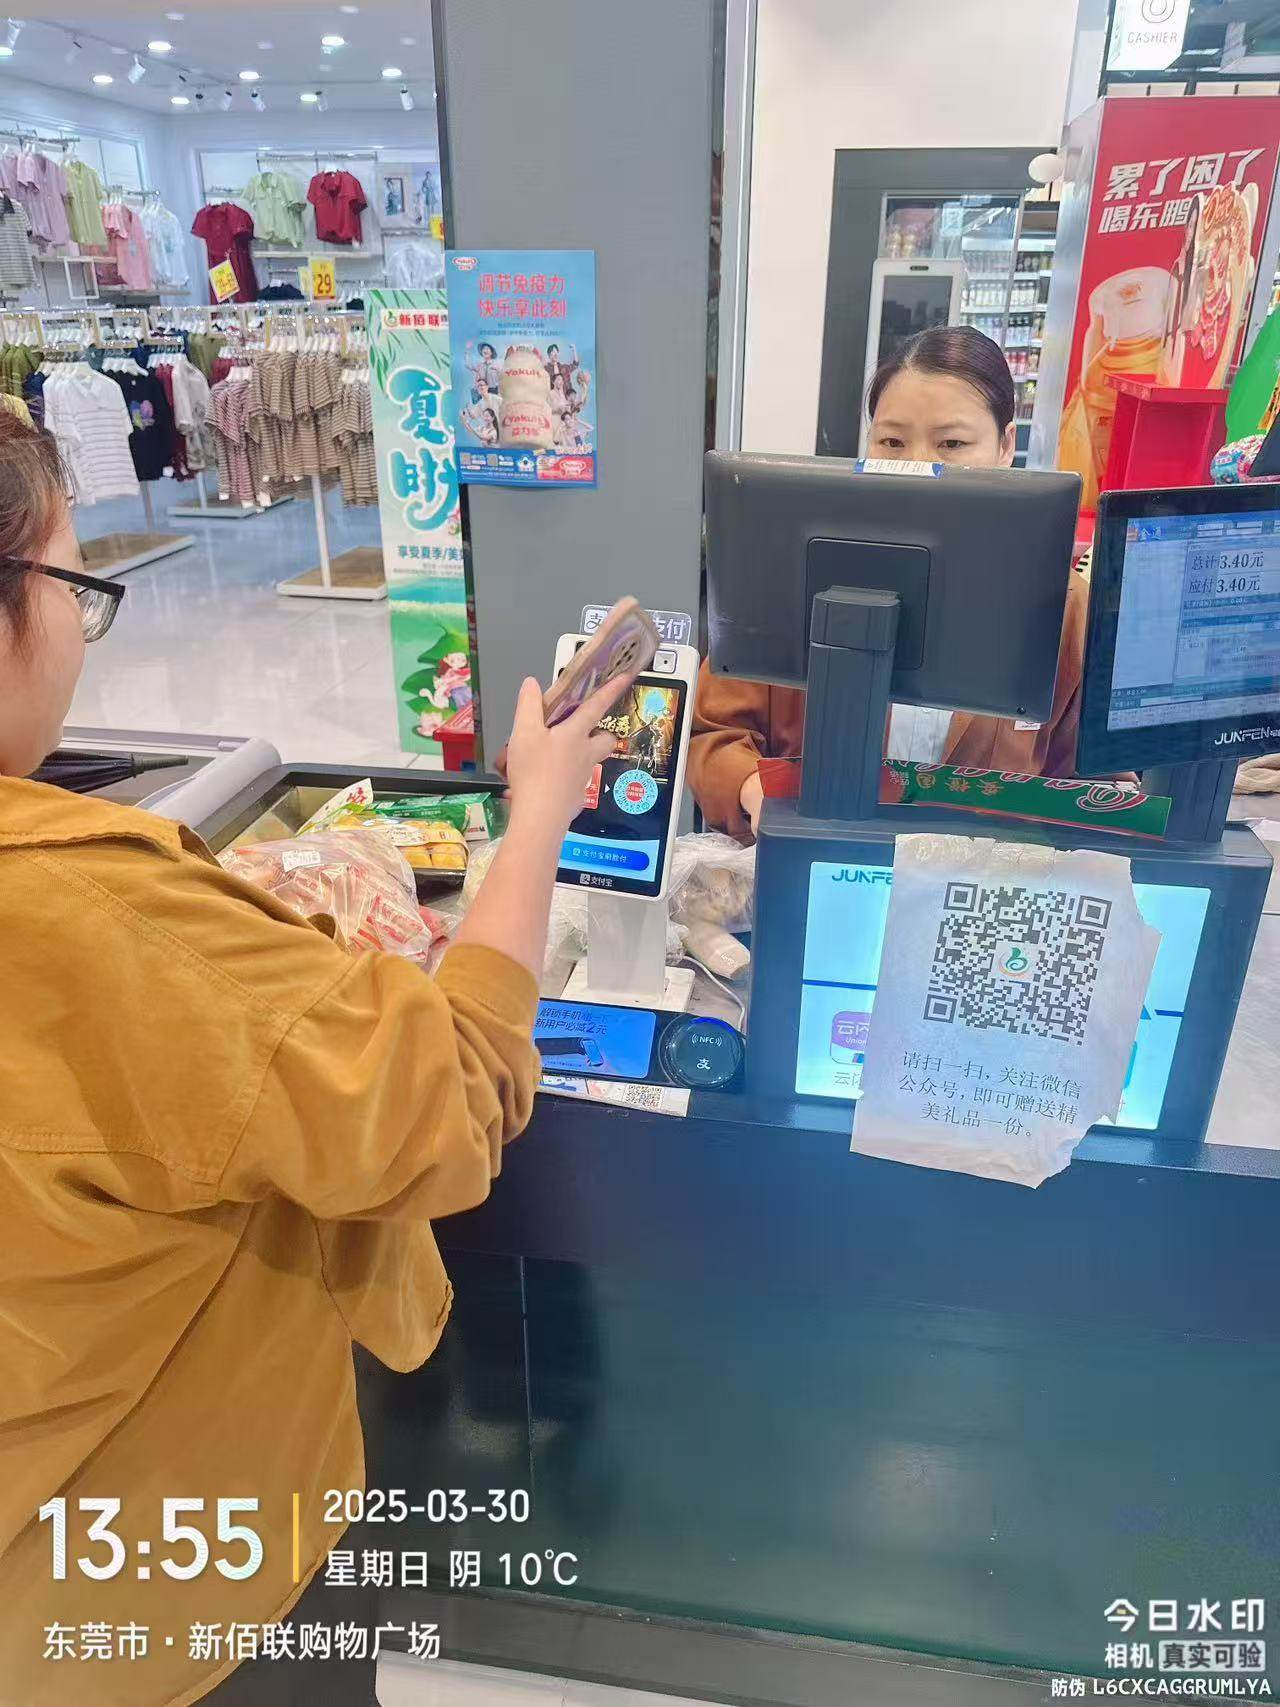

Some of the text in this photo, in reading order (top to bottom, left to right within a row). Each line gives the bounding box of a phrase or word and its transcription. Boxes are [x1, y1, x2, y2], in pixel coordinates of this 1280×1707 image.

[1127, 31, 1178, 44] CASHIER
[1103, 148, 1266, 201] 累了困了
[317, 273, 331, 294] 29
[479, 273, 566, 295] 调节免疫力
[479, 299, 567, 319] 快乐享此刻
[386, 366, 453, 446] 夏
[398, 544, 463, 560] 享受夏季/美
[699, 1036, 715, 1044] NFC
